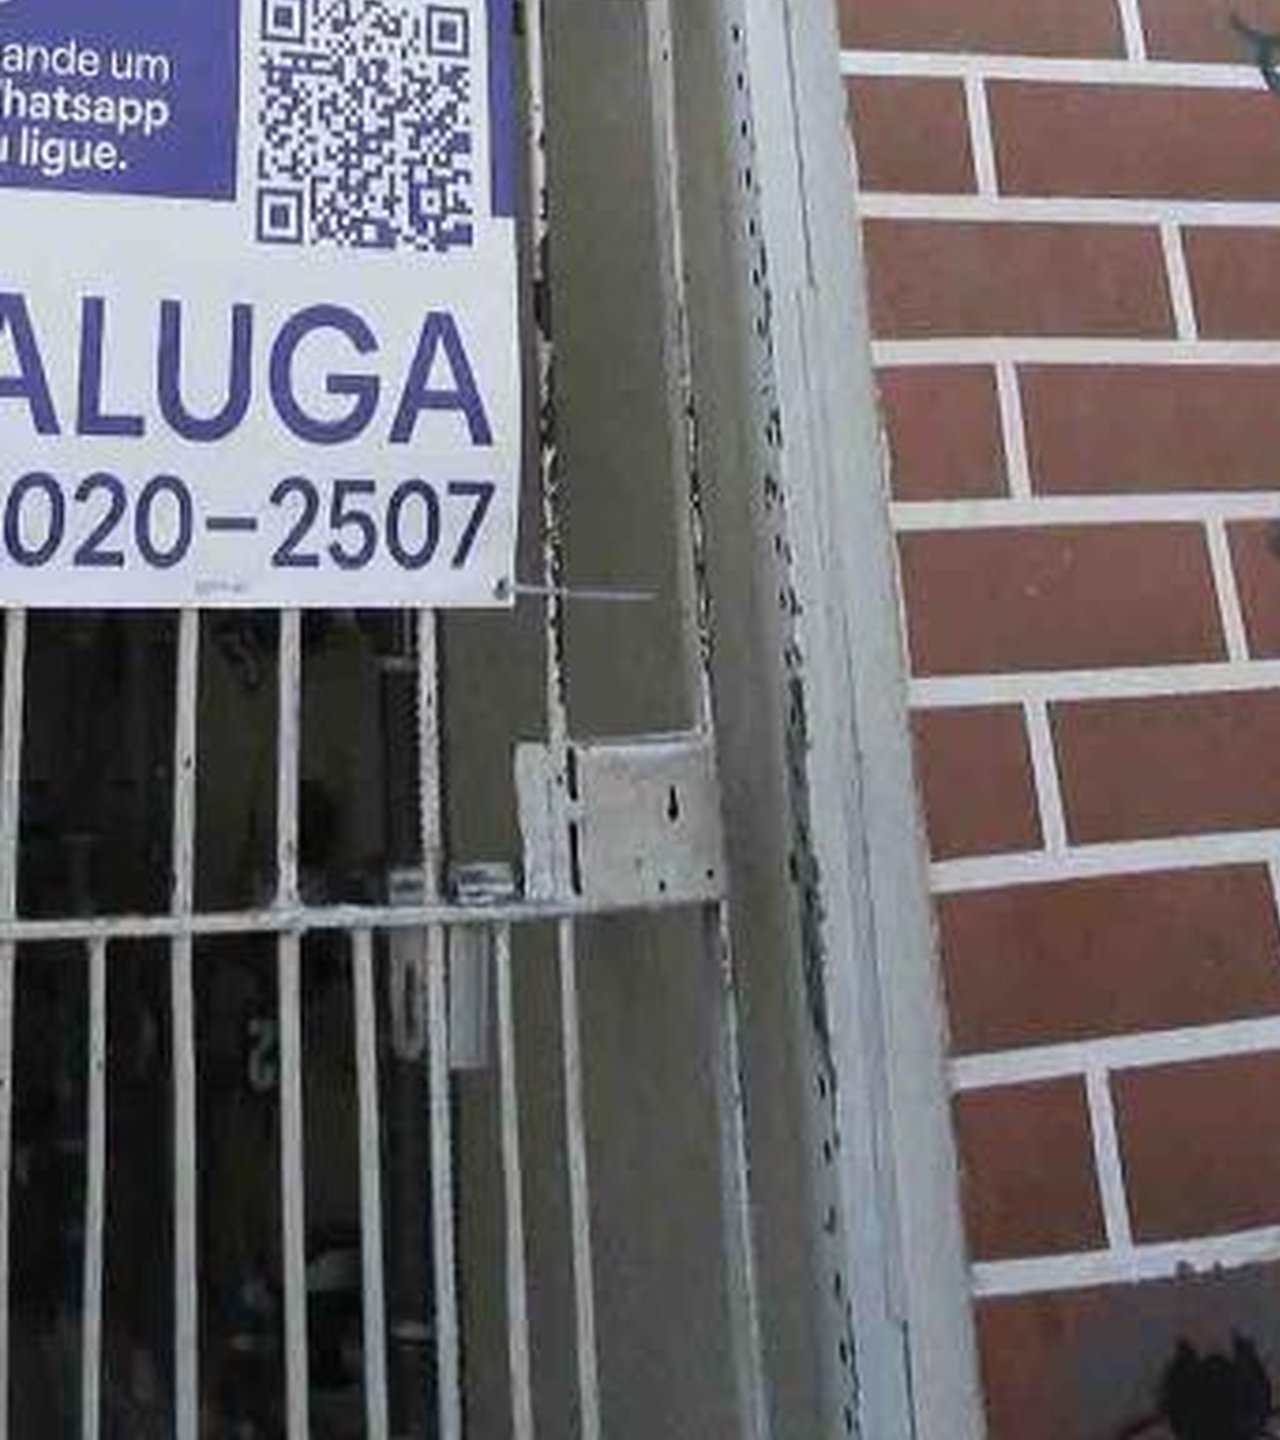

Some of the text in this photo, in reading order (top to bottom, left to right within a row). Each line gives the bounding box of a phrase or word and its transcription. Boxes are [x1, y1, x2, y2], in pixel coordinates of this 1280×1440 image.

[2, 39, 170, 83] ande um
[3, 77, 170, 136] hatsapp
[19, 126, 127, 177] ligue.
[0, 292, 493, 446] ALUGA
[3, 472, 496, 571] 020-2507
